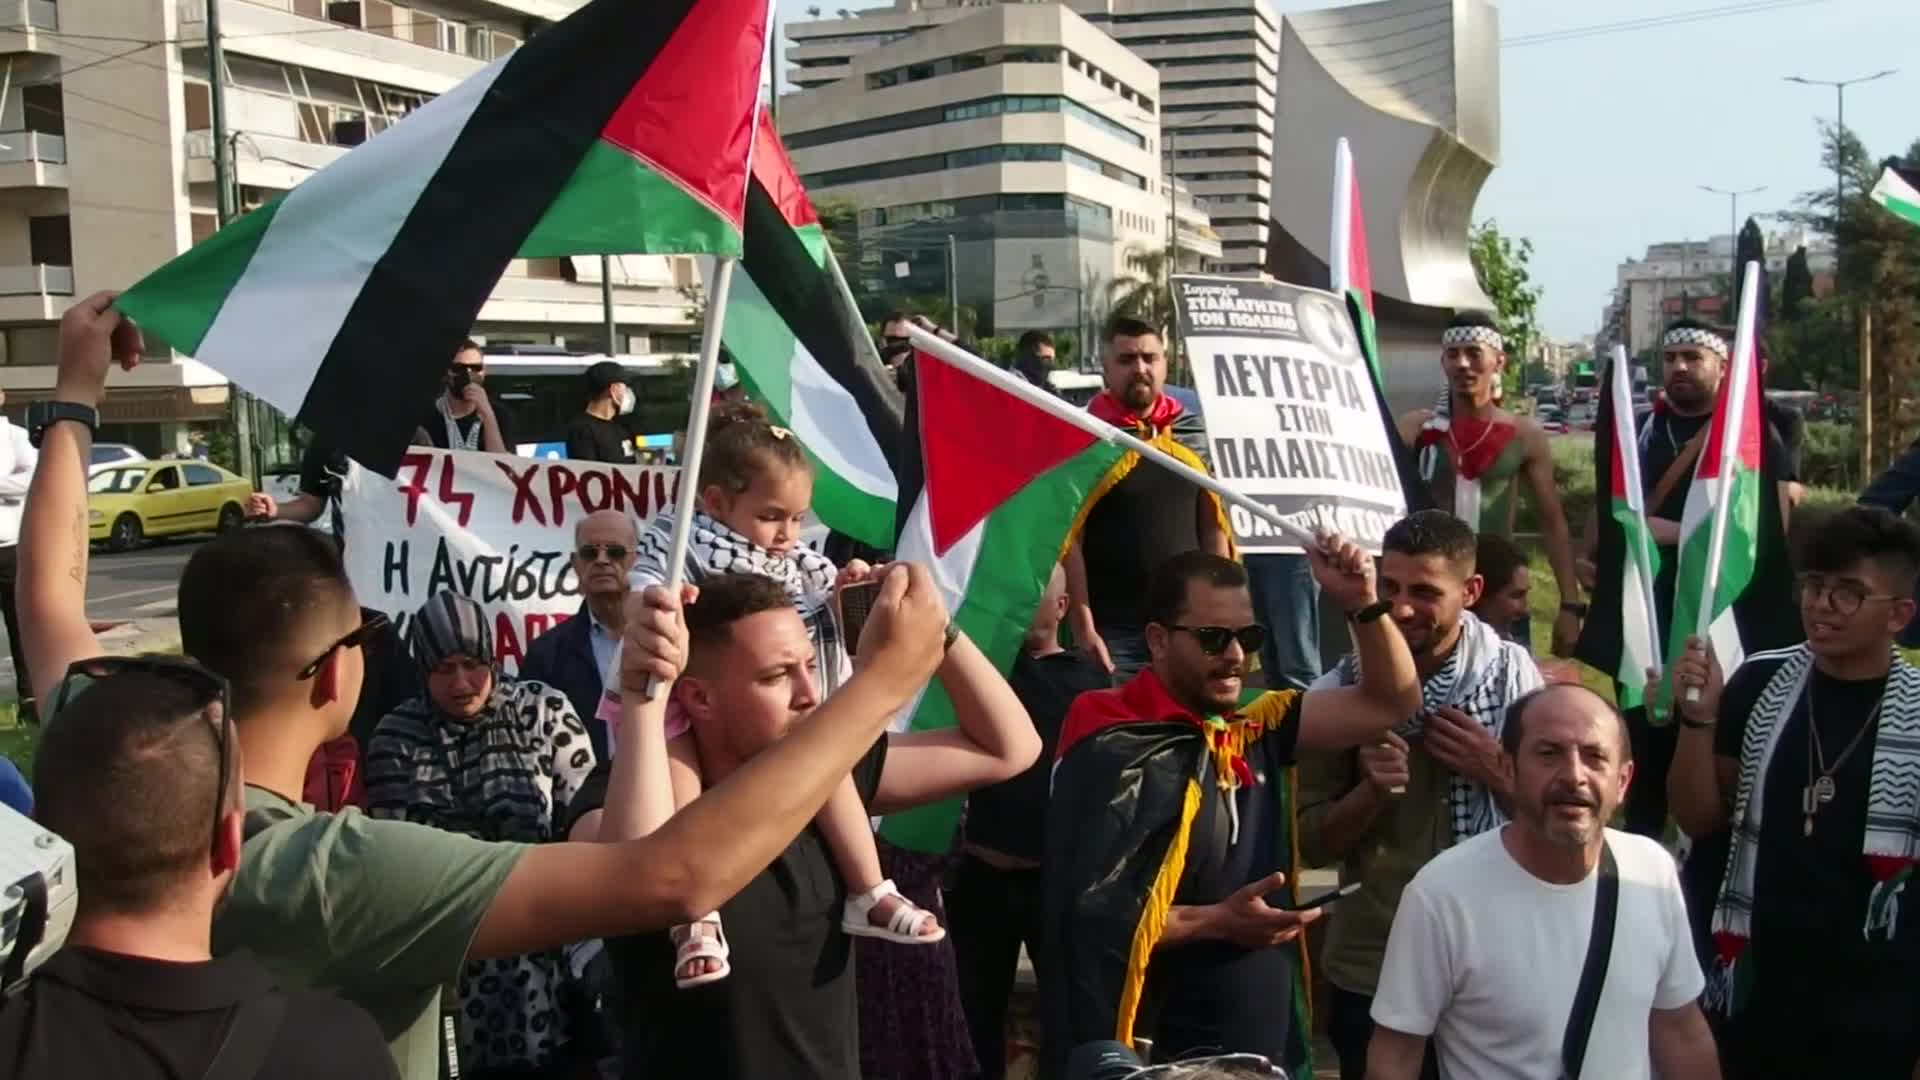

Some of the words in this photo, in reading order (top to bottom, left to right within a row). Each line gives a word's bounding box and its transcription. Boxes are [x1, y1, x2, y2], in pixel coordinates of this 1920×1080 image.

[1186, 297, 1295, 317] ΣΤΑΜΑΤΗΣΤΕ
[1189, 312, 1225, 326] ΤΟΝ
[1229, 312, 1298, 331] ΠΟΛΕΜΟ
[1213, 354, 1366, 412] ΛΕΥΤΕΡΙΑ
[1275, 404, 1334, 436] ΣΤΗΝ
[397, 453, 475, 527] 74
[1214, 437, 1399, 492] ΠΑΛΑΙΣΤΙΝΗ
[384, 540, 409, 594] Η
